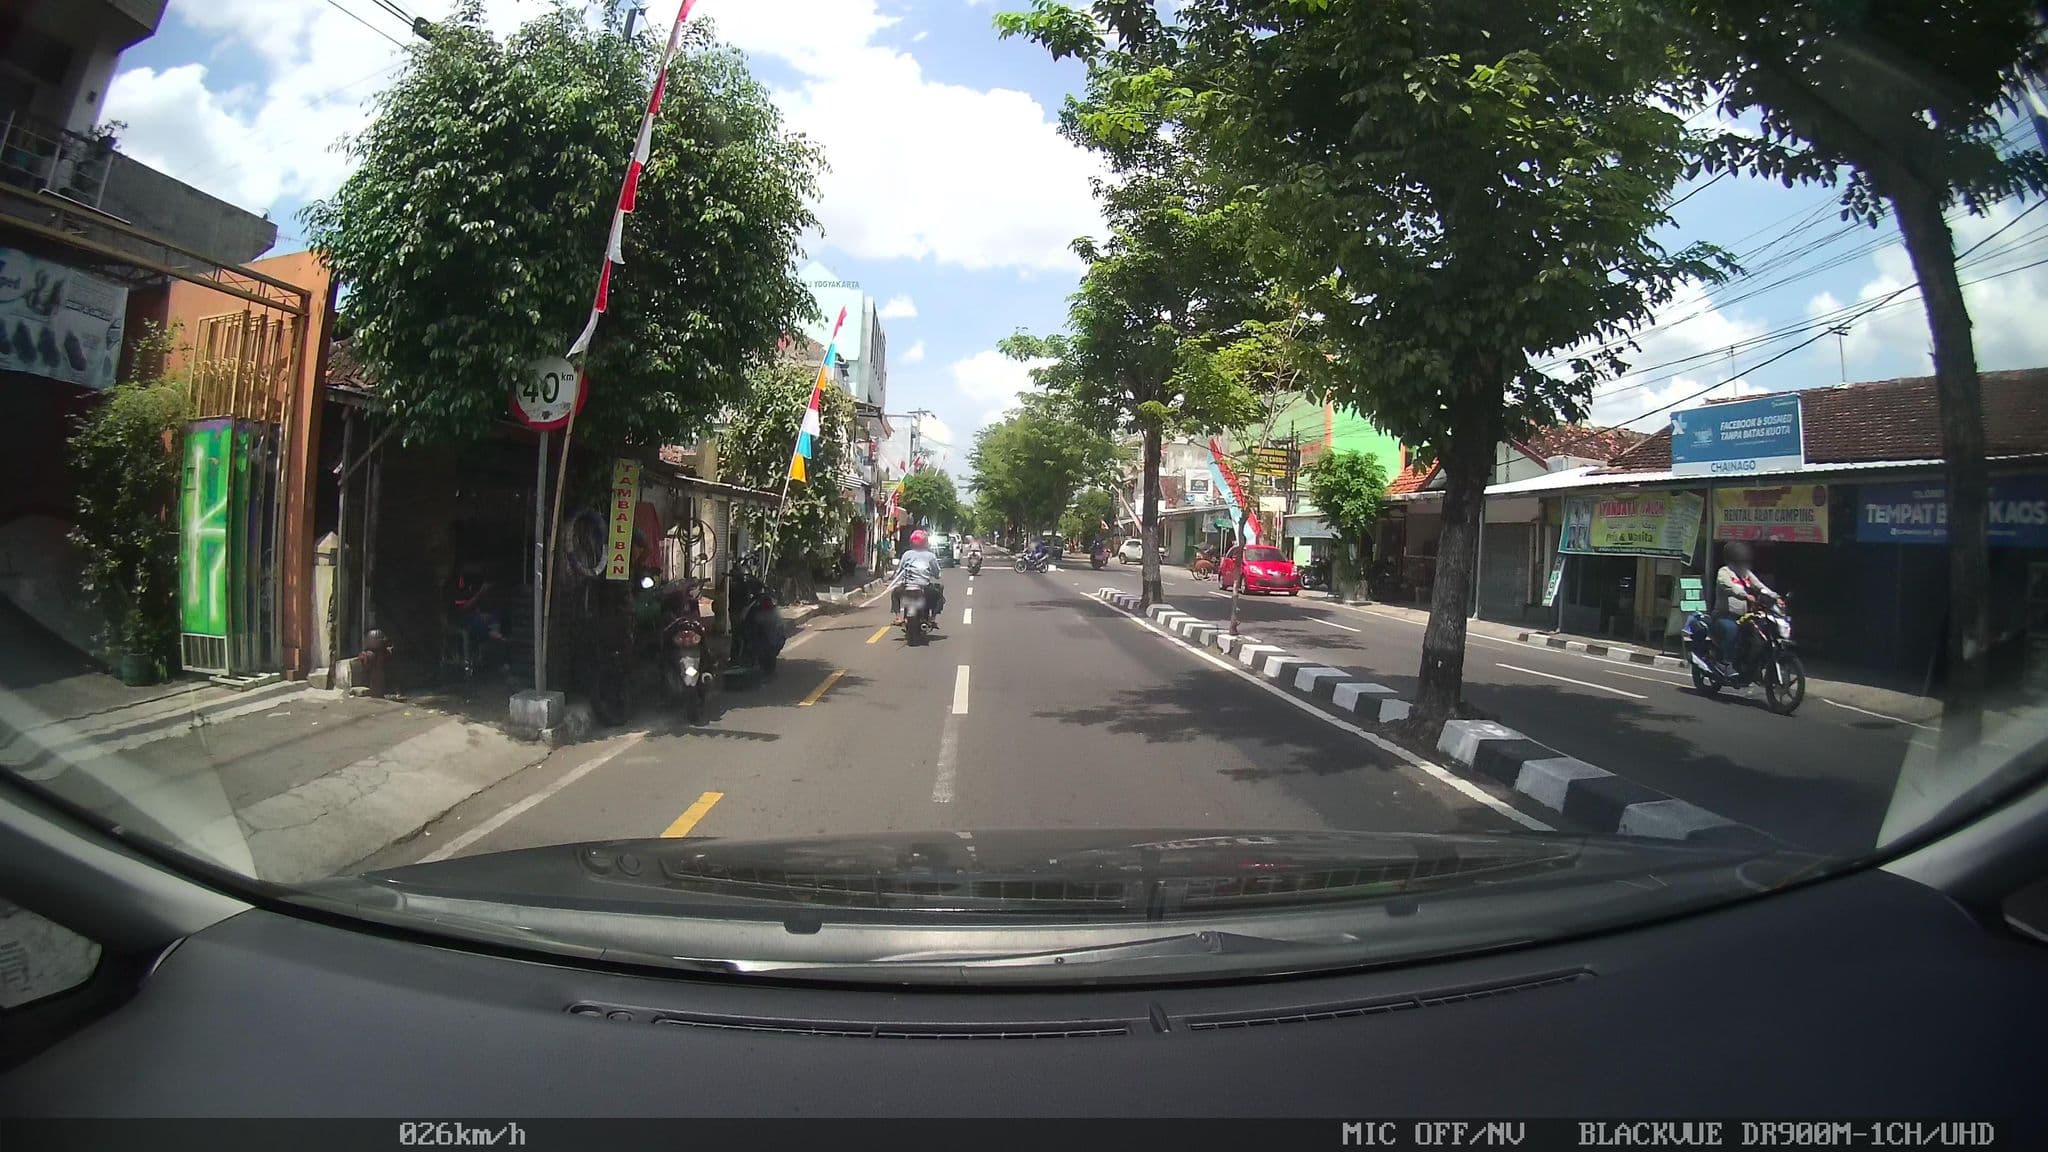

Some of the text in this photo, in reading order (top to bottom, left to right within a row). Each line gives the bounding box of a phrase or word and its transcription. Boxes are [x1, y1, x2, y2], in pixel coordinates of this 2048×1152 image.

[814, 280, 860, 289] YOGYAKARTA
[522, 371, 575, 404] 40 km
[1720, 418, 1758, 431] FACEBOOK
[1763, 414, 1793, 426] SOSMED
[1720, 429, 1742, 441] TANPA
[1743, 427, 1765, 439] BATAS
[1765, 425, 1791, 437] KUOTA
[1711, 460, 1756, 473] CHAINAGO
[613, 465, 633, 574] TAMBAL BAN
[1723, 508, 1753, 521] RENTAL
[1865, 503, 1934, 524] TEMPAT
[1988, 501, 2047, 524] KAOS
